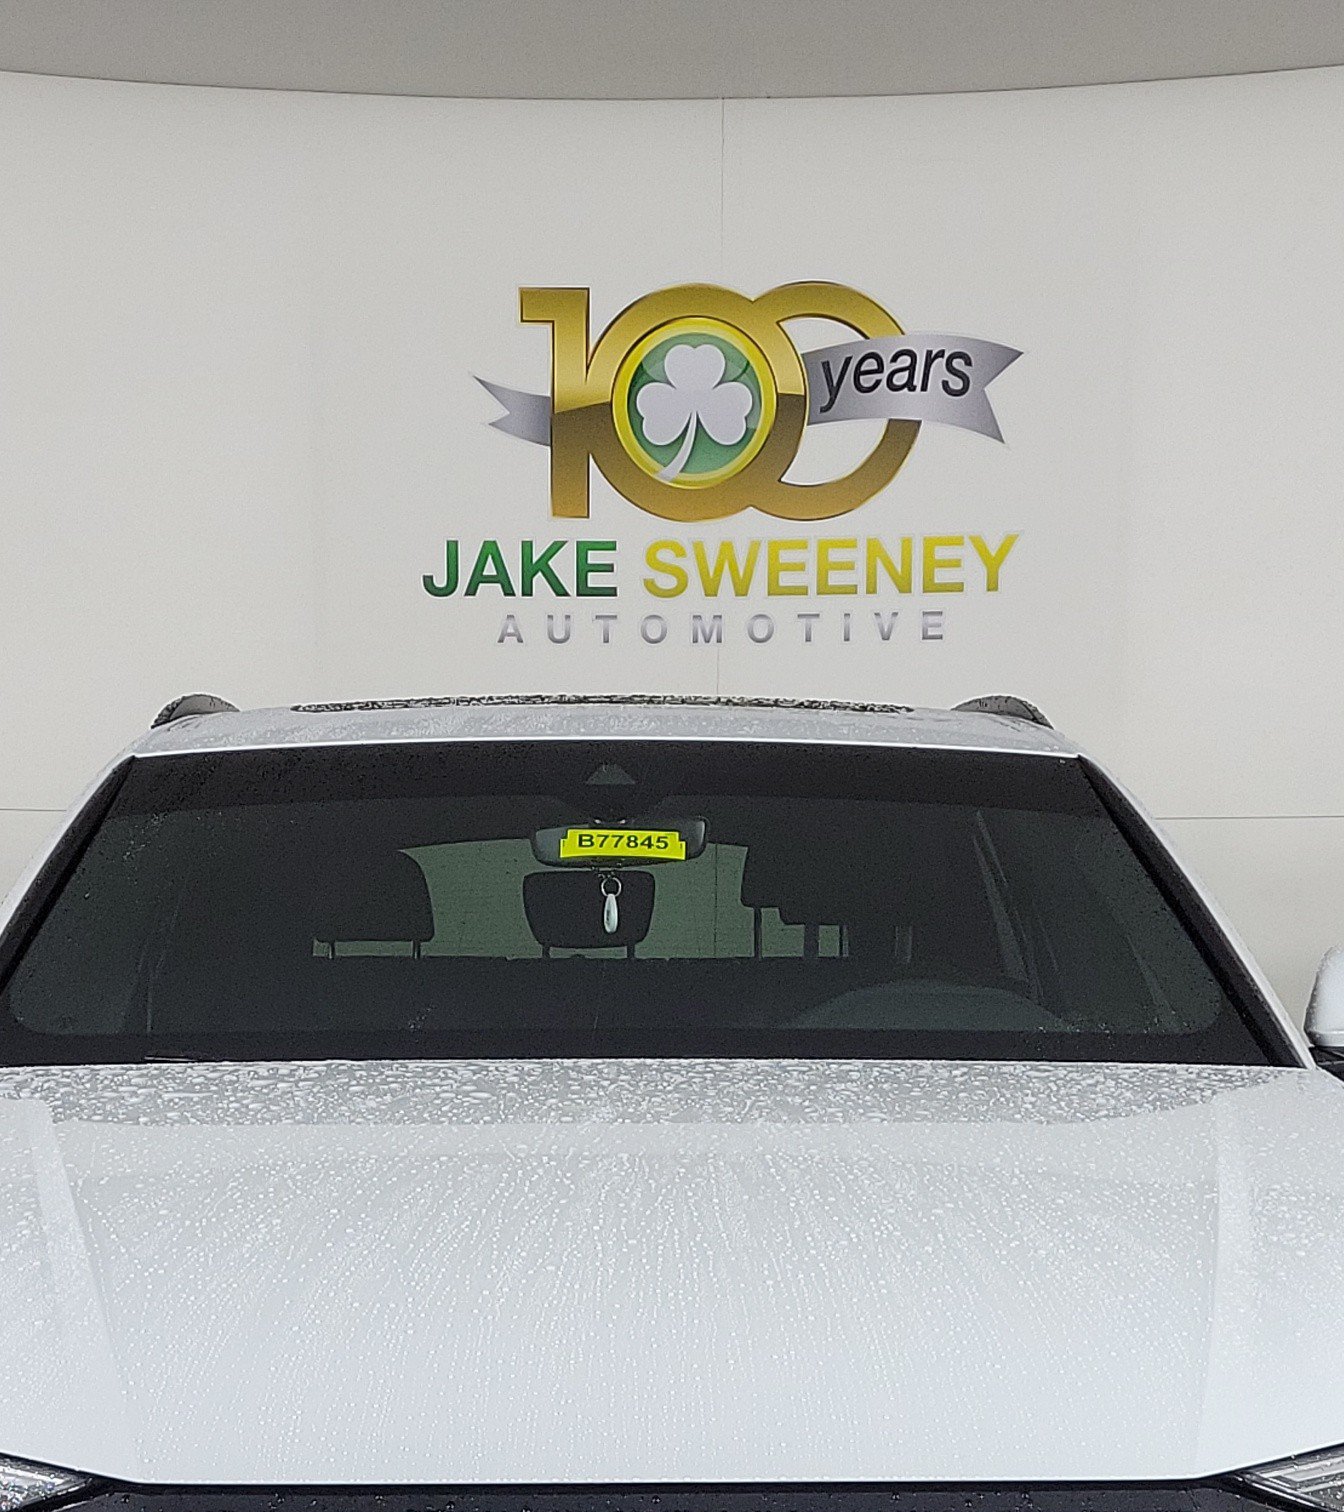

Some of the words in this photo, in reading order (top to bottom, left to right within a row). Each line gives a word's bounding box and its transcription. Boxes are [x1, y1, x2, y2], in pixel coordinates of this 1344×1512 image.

[519, 280, 922, 522] 100
[821, 349, 973, 412] years
[422, 539, 618, 598] JAKE
[642, 533, 1020, 598] SWEENEY
[497, 610, 945, 645] AUTOMOTIVE
[578, 833, 669, 850] B77845
